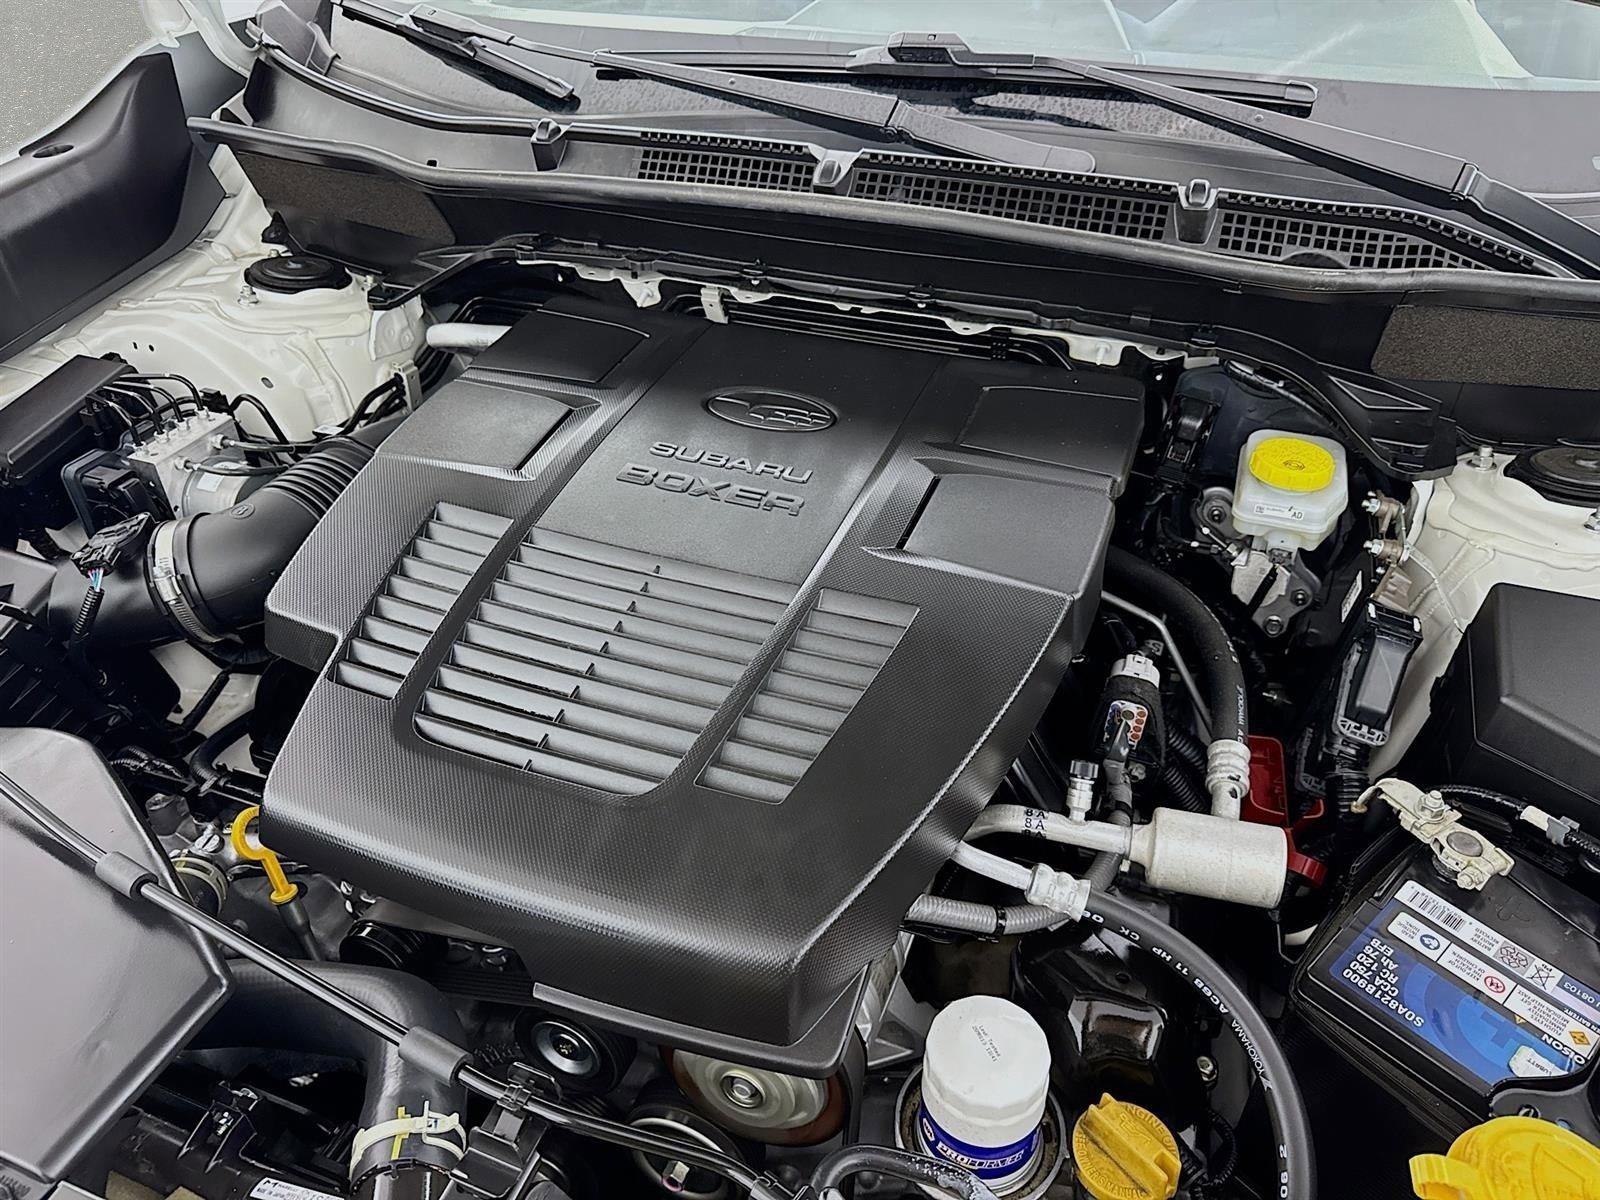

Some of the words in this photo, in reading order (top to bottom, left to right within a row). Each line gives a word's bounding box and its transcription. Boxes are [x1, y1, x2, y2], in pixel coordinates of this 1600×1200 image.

[648, 440, 813, 484] SUBARU
[615, 462, 805, 517] BOXER
[1119, 926, 1141, 941] CK
[1152, 946, 1174, 962] HP
[1363, 945, 1379, 959] 76
[1370, 938, 1393, 957] EFB
[1349, 961, 1373, 978] 750
[1356, 953, 1378, 971] 120
[1380, 955, 1399, 971] Ah
[1379, 967, 1399, 983] RC
[1374, 976, 1399, 996] CCA
[1564, 982, 1595, 1003] 08103
[1230, 1018, 1264, 1074] YOKOHAMA
[1541, 1035, 1586, 1066] OISON
[1125, 1105, 1166, 1135] NGINE
